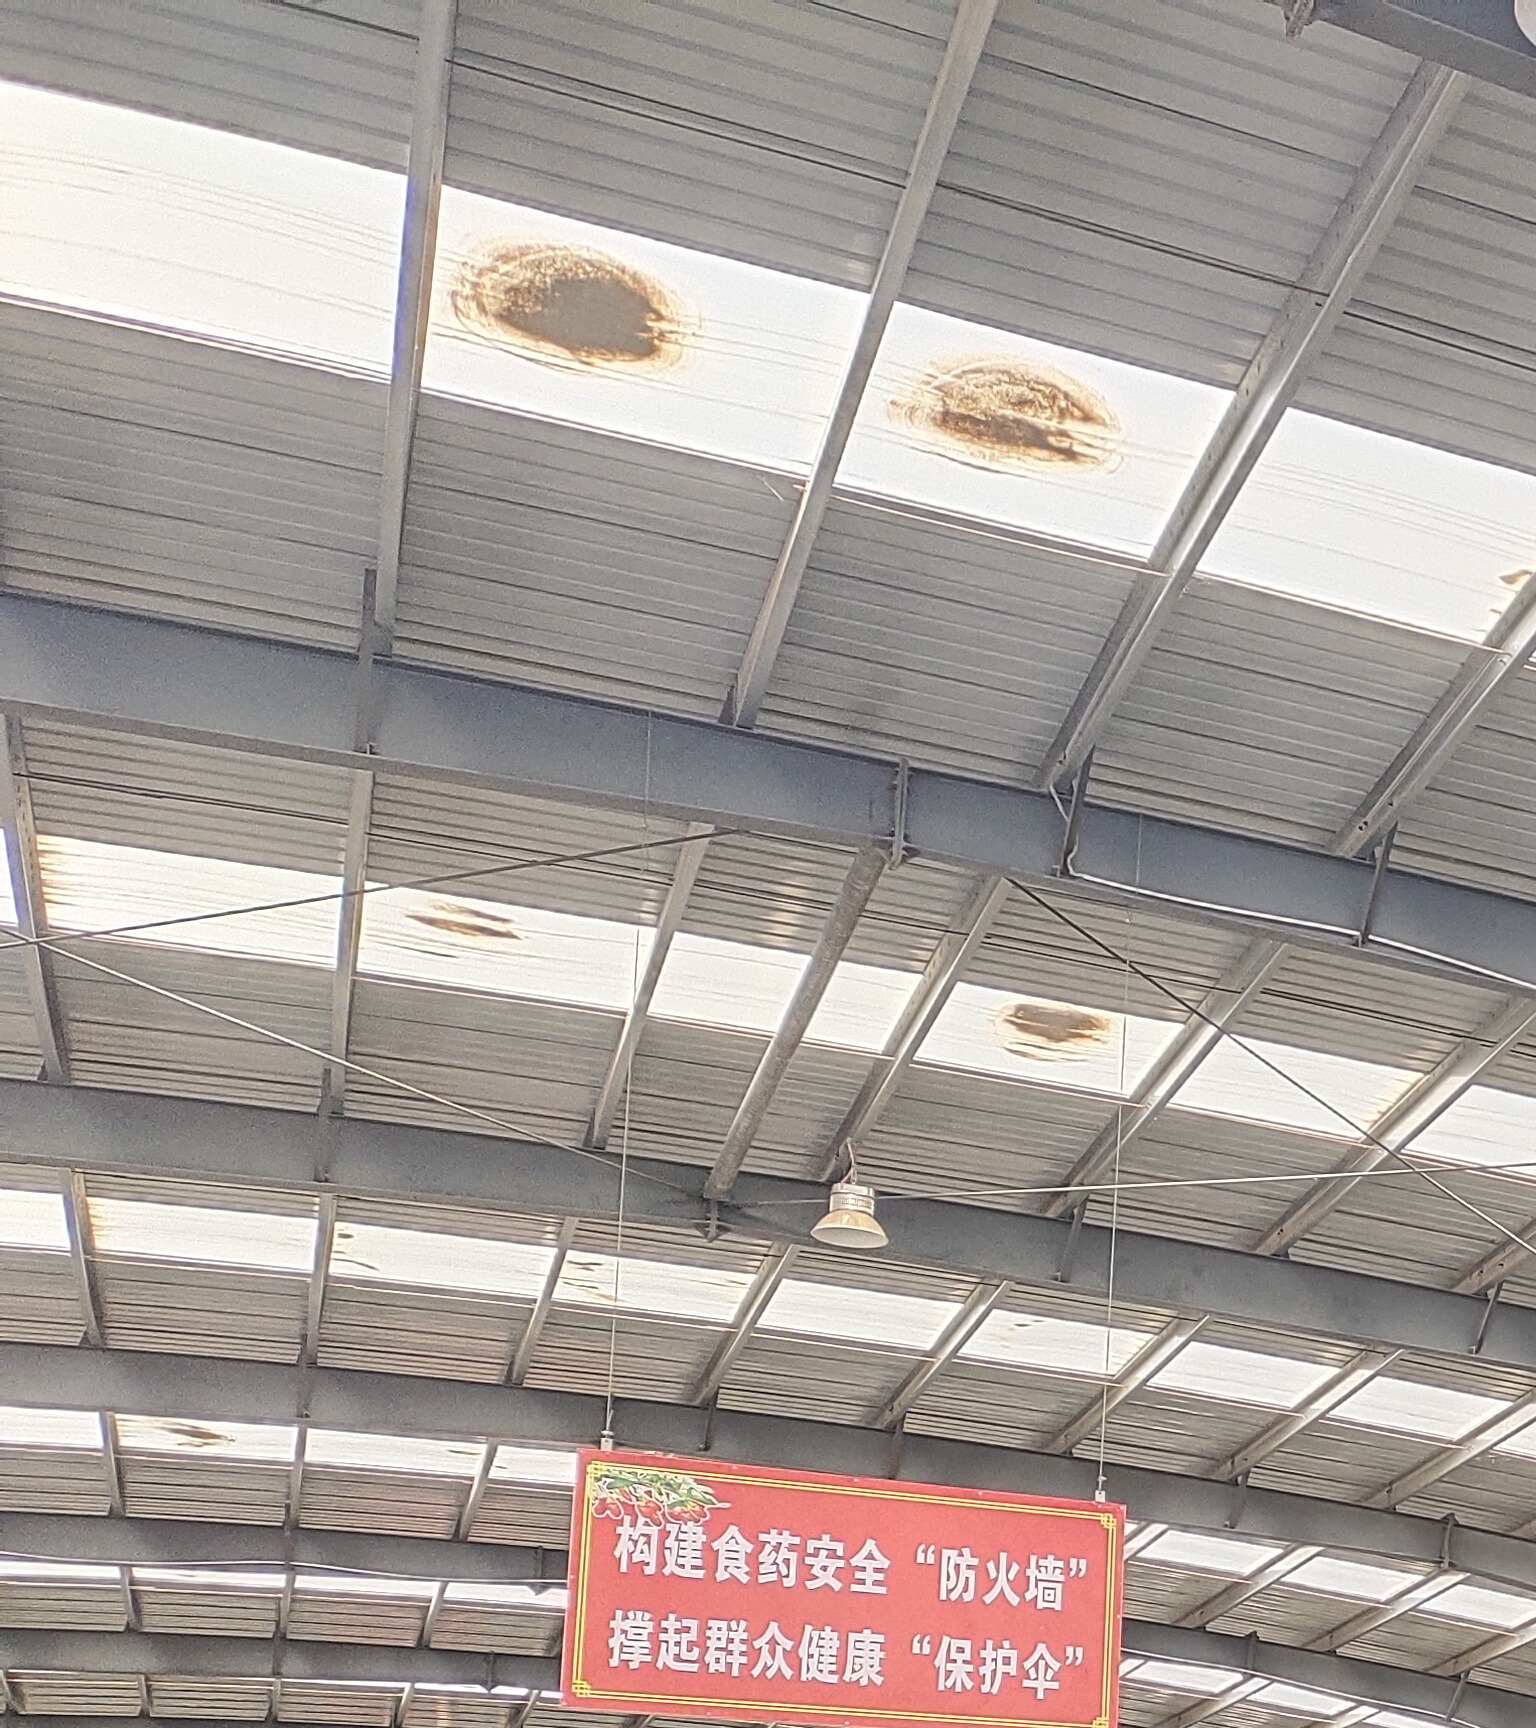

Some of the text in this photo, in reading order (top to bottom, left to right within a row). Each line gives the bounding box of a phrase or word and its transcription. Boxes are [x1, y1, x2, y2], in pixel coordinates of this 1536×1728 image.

[613, 1514, 1087, 1611] 构建食药安全“防火墙”
[607, 1610, 1084, 1700] 撑起群众健康“保护伞”
